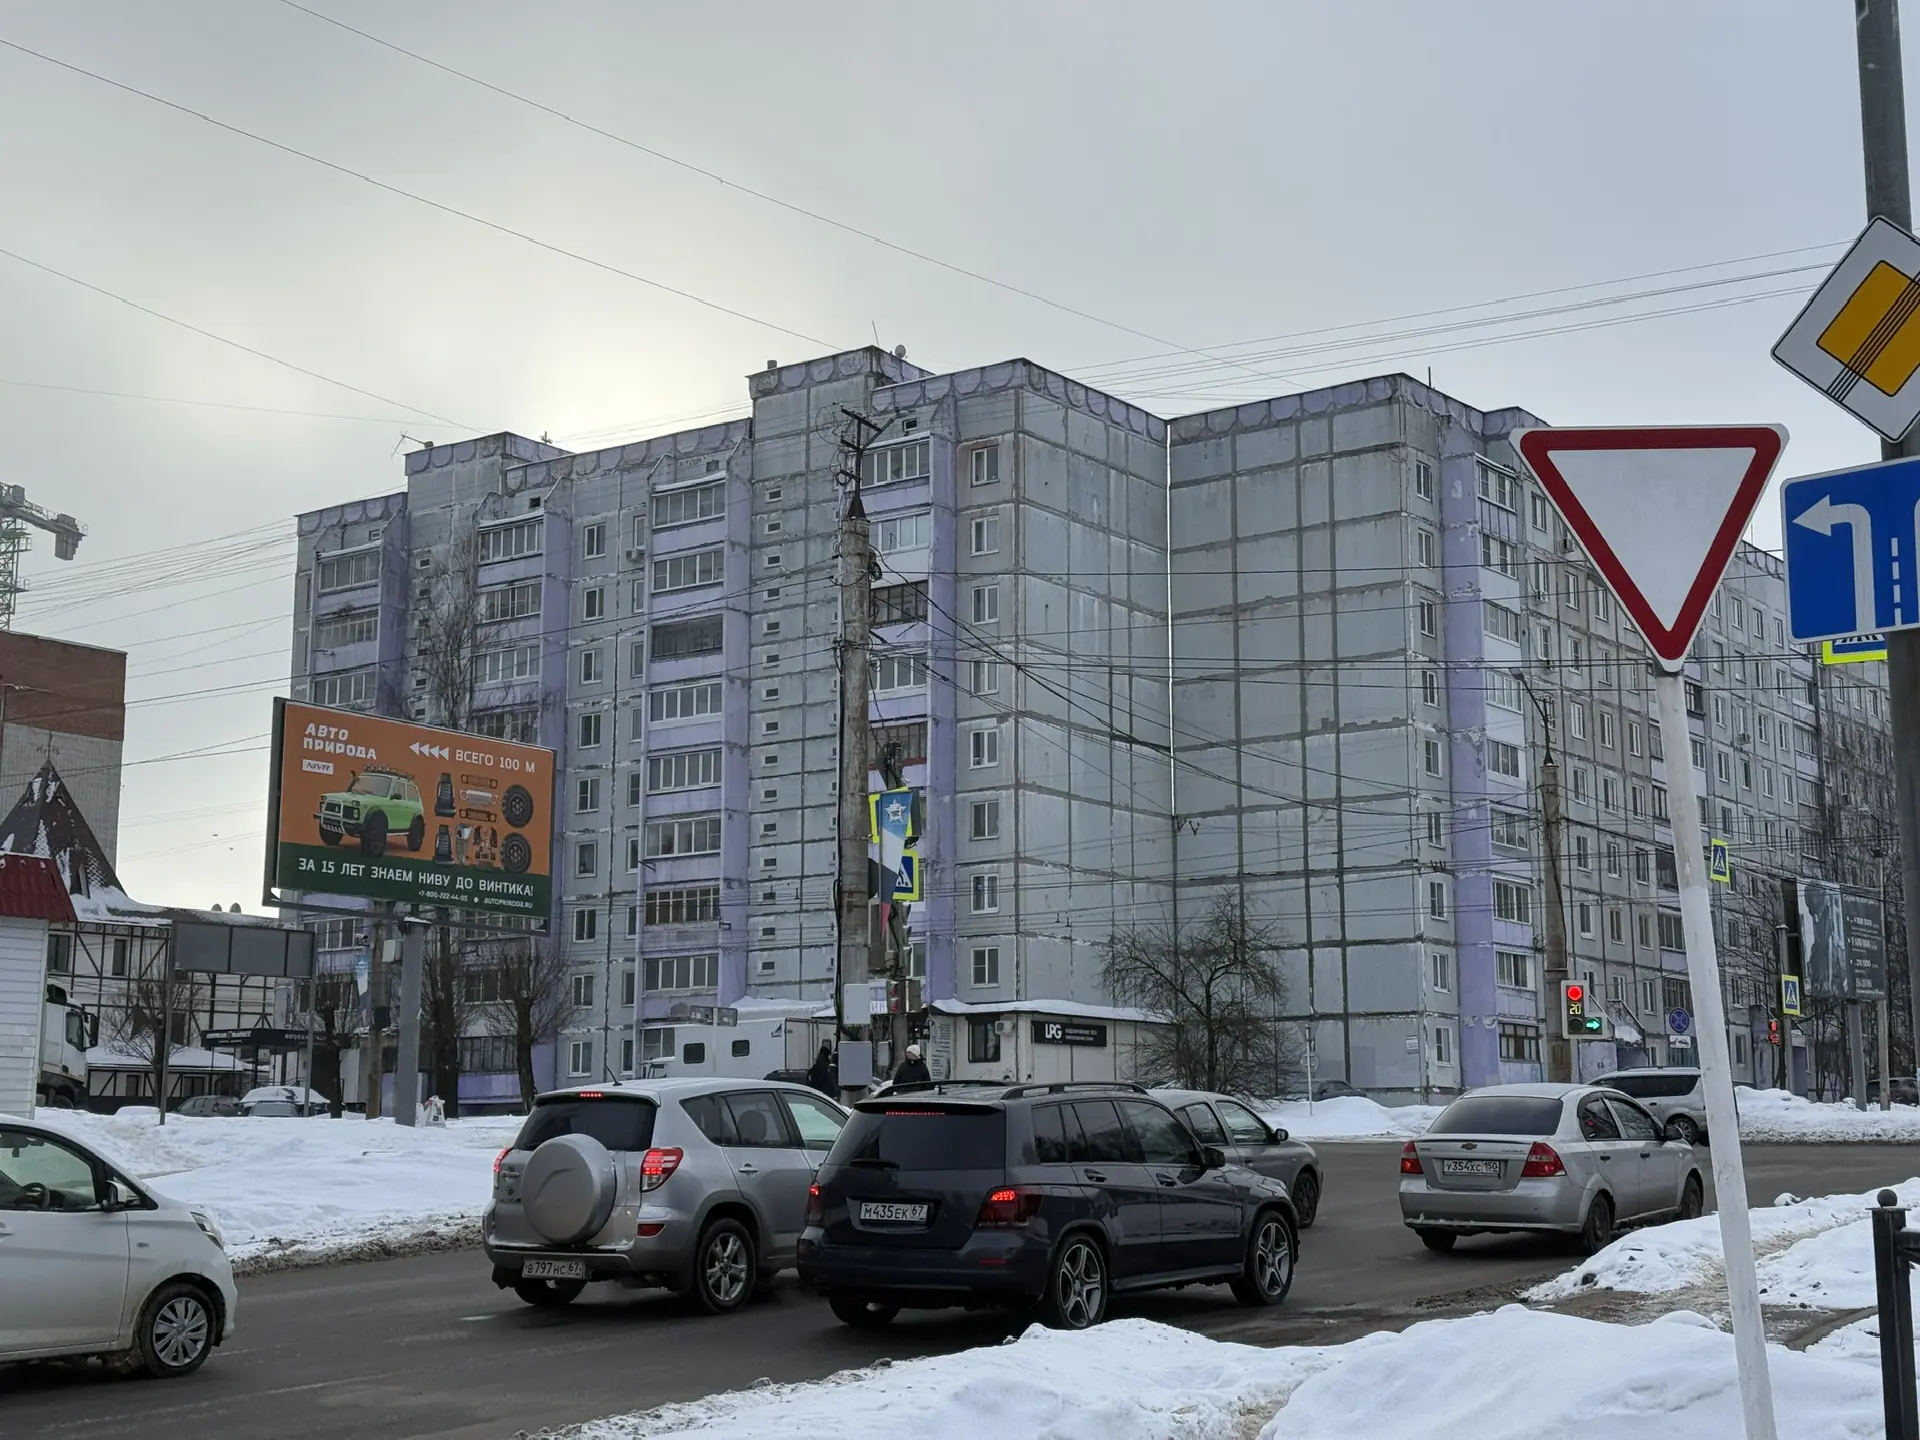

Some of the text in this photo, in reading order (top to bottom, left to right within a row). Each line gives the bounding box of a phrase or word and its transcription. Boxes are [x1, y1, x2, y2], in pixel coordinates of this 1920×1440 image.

[305, 722, 349, 741] АВТО
[303, 736, 377, 761] ПРИРОДА
[455, 748, 536, 773] ВСЕГО 100 М
[298, 857, 534, 896] ЗА 15 ЛЕТ ЗНАЕМ НИВУ ДО ВИНТИКА!
[1569, 1003, 1582, 1015] 20
[1045, 1023, 1062, 1039] LPG
